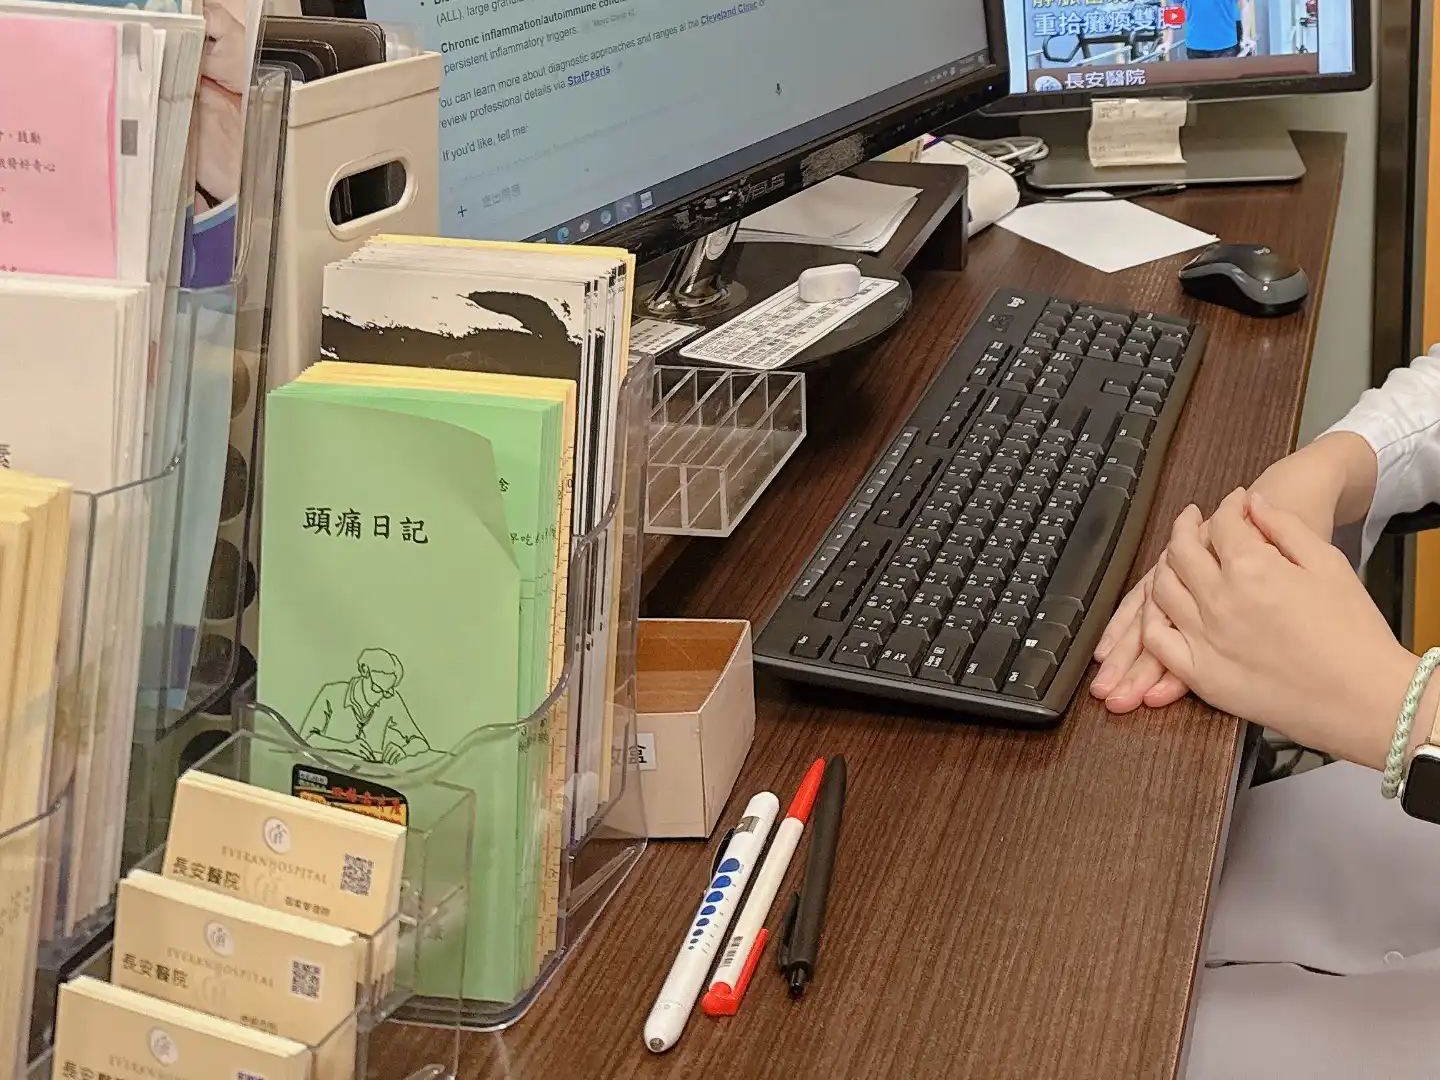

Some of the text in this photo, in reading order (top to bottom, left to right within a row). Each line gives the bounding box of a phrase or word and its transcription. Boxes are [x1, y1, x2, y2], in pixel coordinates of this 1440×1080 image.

[440, 32, 479, 54] Chronic
[480, 0, 597, 42] inflammation/autoimmune
[465, 0, 489, 18] large
[443, 51, 488, 75] persistent
[488, 34, 544, 61] inflammatory
[454, 90, 471, 104] can
[473, 81, 496, 98] learn
[498, 75, 520, 90] more
[521, 65, 546, 82] about
[547, 51, 589, 75] diagnostic
[589, 37, 635, 62] approaches
[636, 32, 650, 45] and
[652, 25, 677, 43] ranges
[700, 5, 736, 26] Cleveland
[1065, 69, 1147, 91] 長安醫院
[469, 93, 522, 121] professional
[523, 82, 551, 101] details
[553, 79, 565, 91] via
[442, 148, 450, 162] If
[451, 140, 476, 163] you'd
[497, 128, 510, 143] tell
[302, 506, 429, 545] 頭痛日記
[172, 856, 241, 891] 長安醫院
[121, 952, 189, 990] 長安醫院
